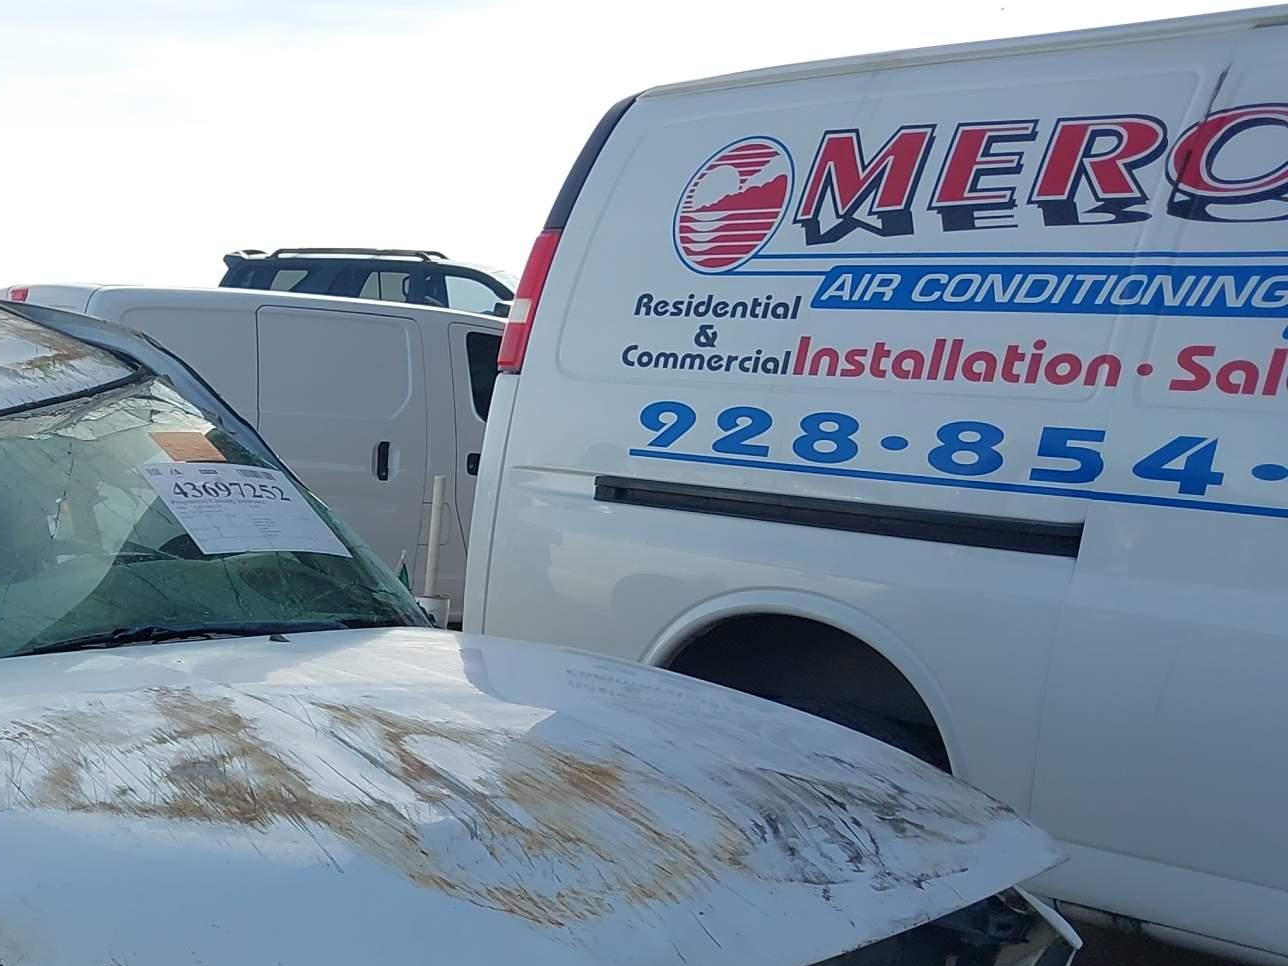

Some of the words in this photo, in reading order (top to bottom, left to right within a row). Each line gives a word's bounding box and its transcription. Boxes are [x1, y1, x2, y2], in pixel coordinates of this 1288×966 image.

[633, 292, 802, 320] Residential
[819, 273, 902, 302] AIR
[911, 273, 1288, 309] CONDITIONING
[693, 324, 718, 348] &
[621, 344, 792, 376] Commercial
[792, 336, 1122, 388] Installation
[1168, 345, 1288, 397] Sal
[173, 481, 292, 502] 43697252
